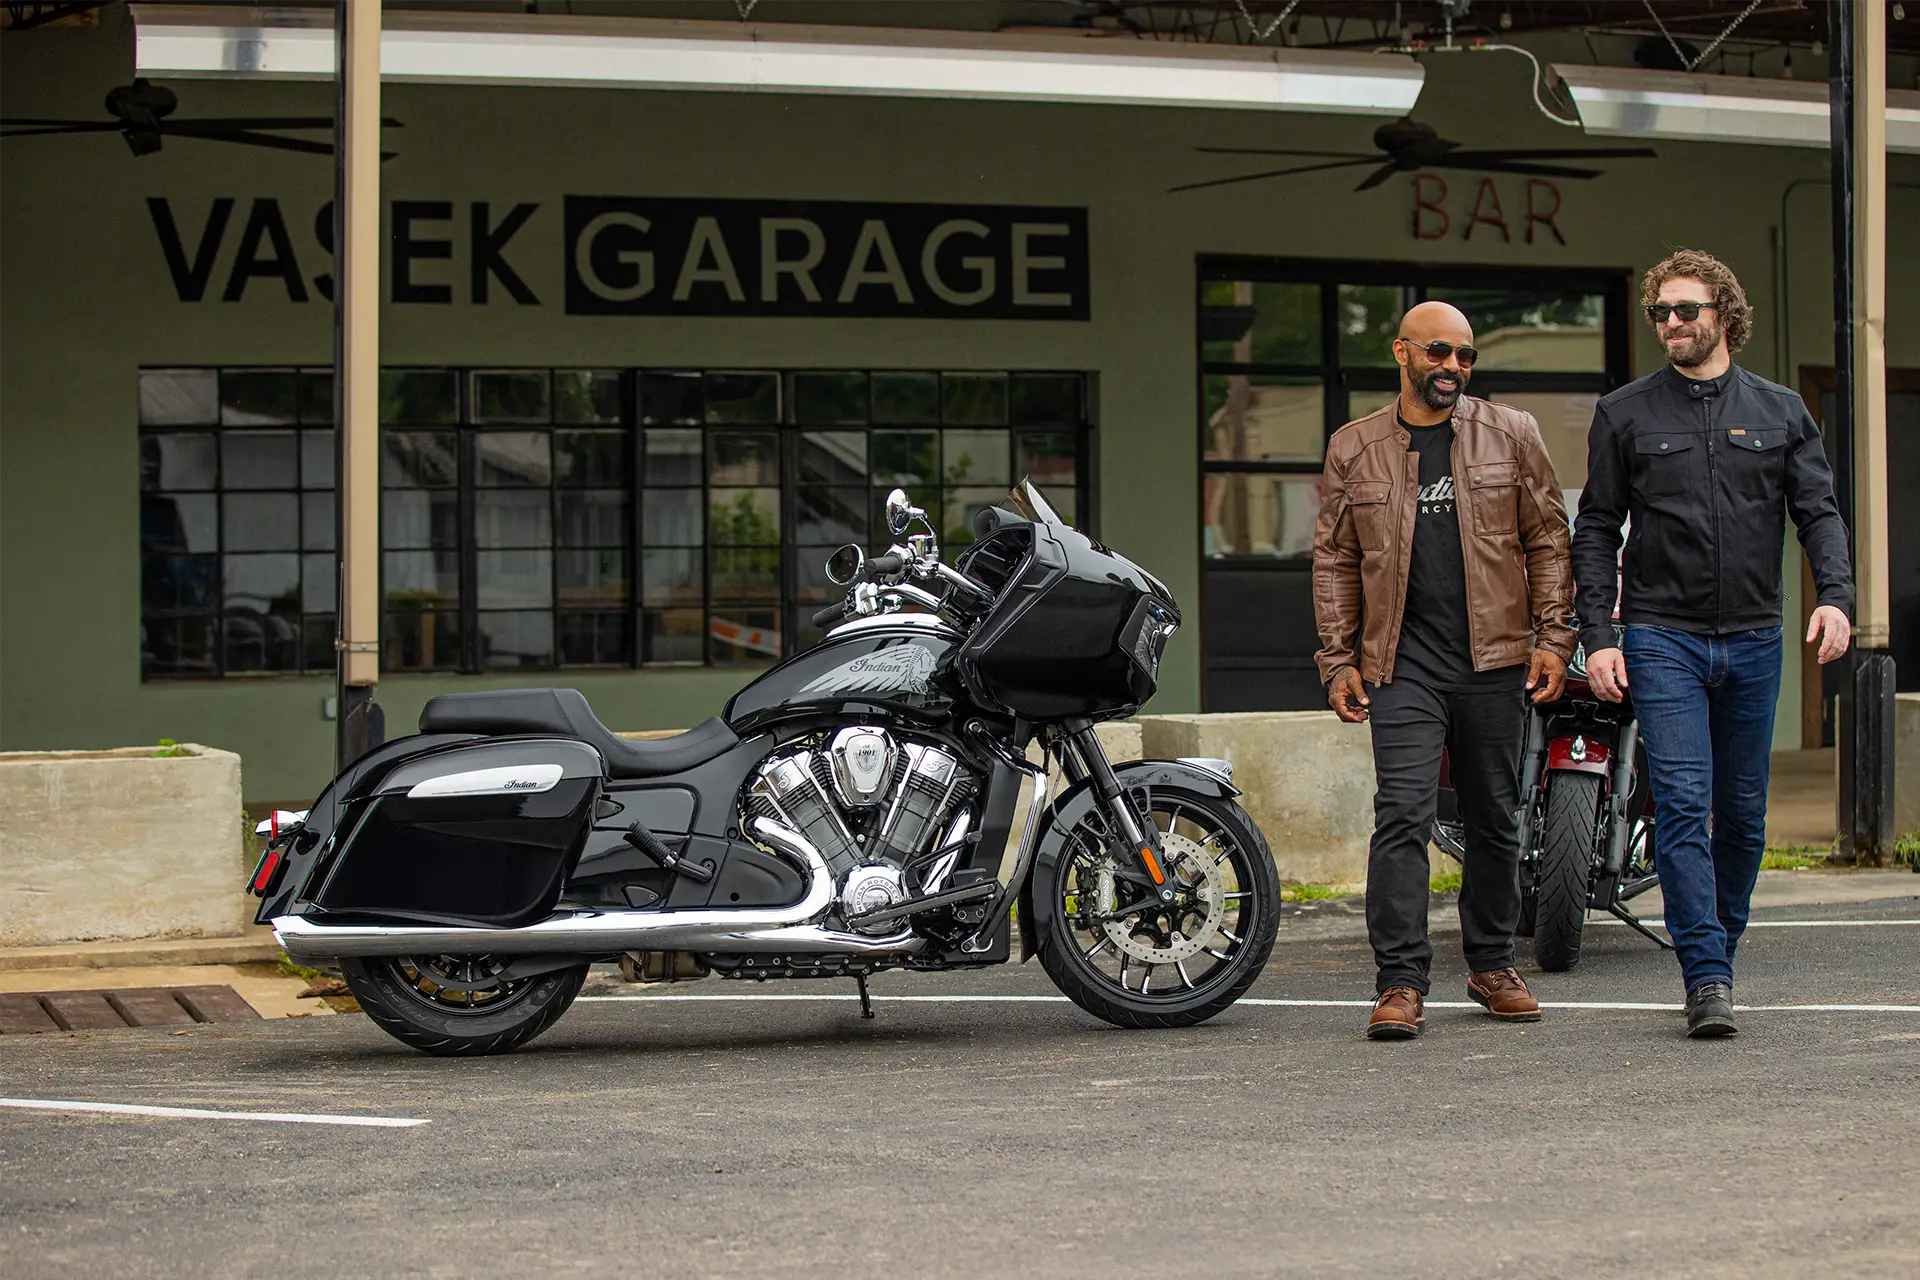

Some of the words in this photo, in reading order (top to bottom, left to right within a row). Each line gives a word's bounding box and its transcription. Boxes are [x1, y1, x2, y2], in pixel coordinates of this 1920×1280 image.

[1412, 172, 1566, 247] BAR
[575, 211, 1072, 306] GARAGE
[850, 659, 902, 673] Indian
[858, 749, 876, 757] 1901
[504, 779, 537, 789] Indian
[1102, 879, 1110, 908] brembo
